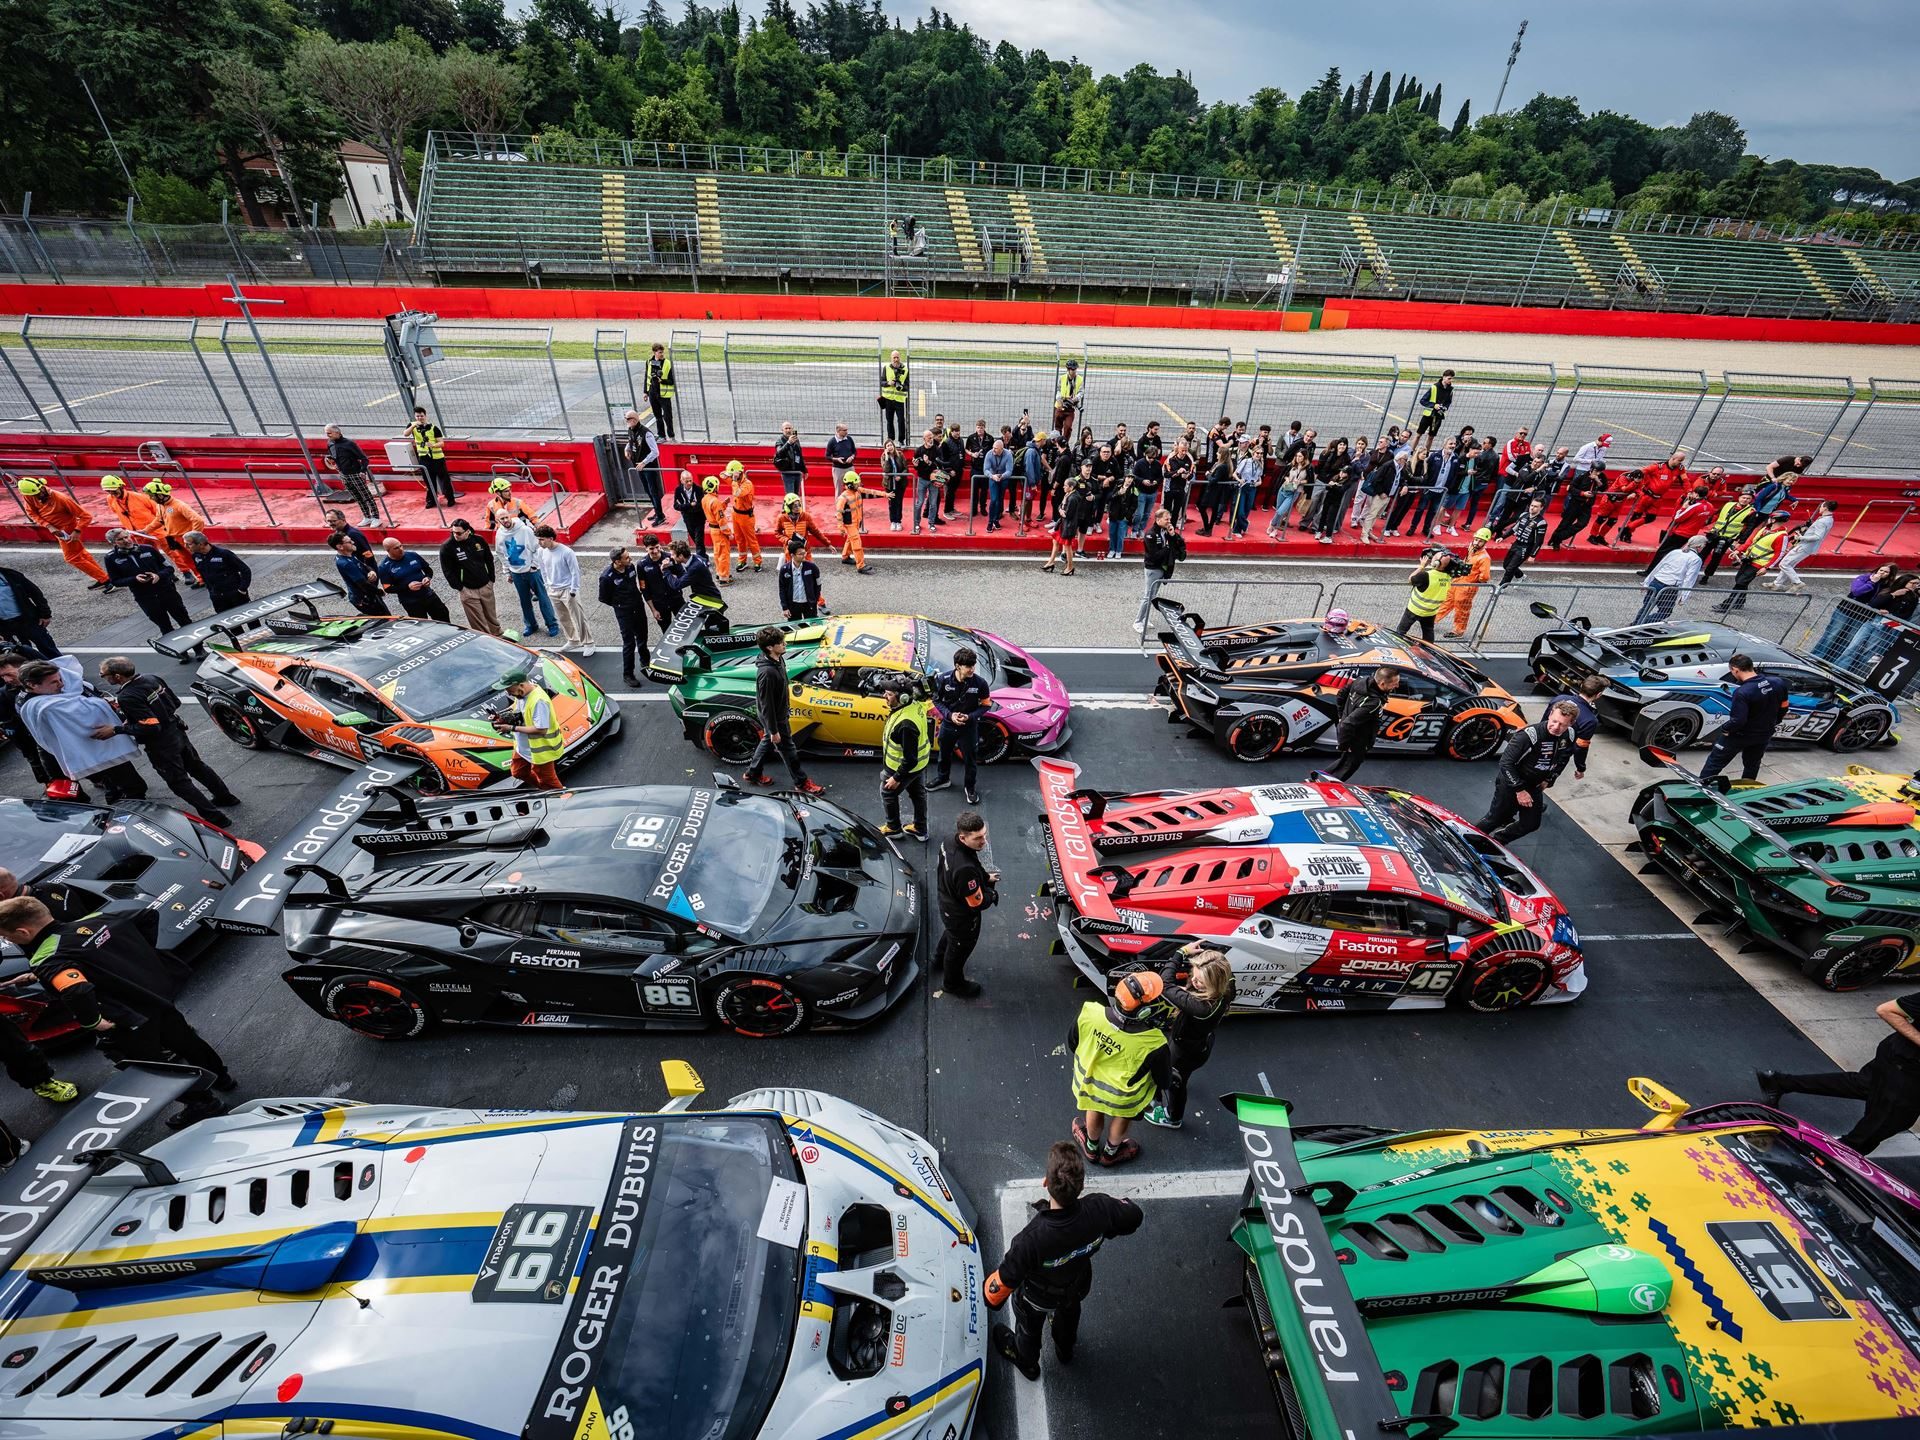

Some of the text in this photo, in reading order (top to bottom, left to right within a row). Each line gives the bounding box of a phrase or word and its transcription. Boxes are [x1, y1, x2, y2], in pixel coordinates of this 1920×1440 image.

[663, 600, 704, 647] randstad
[387, 635, 426, 652] 33
[705, 634, 757, 645] ROGER DUBU
[1203, 637, 1259, 648] ROGER DUBUIS
[375, 655, 431, 684] ROGER
[428, 630, 478, 658] DUBUIS
[1878, 656, 1910, 690] 3
[395, 685, 407, 696] 33
[288, 697, 323, 718] Fastron
[809, 696, 854, 709] Fastron
[1411, 720, 1444, 737] 25
[1801, 716, 1831, 734] 32
[444, 758, 469, 769] MPC
[283, 766, 397, 863] randstad
[1040, 769, 1090, 860] randstad
[1792, 815, 1829, 825] DUBUIS
[626, 816, 665, 848] 86
[1316, 812, 1351, 841] 46
[359, 831, 449, 844] ROGER DUBUIS
[653, 789, 711, 900] ROGER DUBUIS
[1099, 832, 1183, 846] ROGER DUBUIS
[1043, 822, 1067, 897] XEKUTORBRNO.CZ
[1308, 863, 1365, 876] ON-LINE
[1394, 836, 1435, 888] ROGER
[54, 864, 82, 885] amica
[688, 892, 706, 912] 86
[176, 897, 215, 931] Fastron
[1114, 908, 1145, 920] KARNA
[1122, 915, 1150, 931] LINE
[1339, 939, 1398, 955] Fastron
[1367, 936, 1398, 944] PERTAMINA
[510, 951, 580, 969] Fastron
[546, 948, 581, 957] PERTAMINA
[1243, 963, 1287, 971] AQUASYS
[1305, 976, 1387, 991] LERAM
[1409, 970, 1453, 990] 46
[644, 985, 692, 1007] 86
[816, 990, 859, 1007] Fastron
[1317, 999, 1346, 1007] AGRATI
[537, 1014, 570, 1023] AGRATI
[1093, 1028, 1122, 1052] MEDIA
[0, 1091, 150, 1256] dstad
[779, 1195, 791, 1224] TECHNICAL
[782, 1190, 798, 1231] SCRUTINEERING
[1731, 1146, 1861, 1270] DUBUIS
[490, 1221, 513, 1264] macron
[494, 1211, 569, 1292] 66
[1242, 1125, 1361, 1382] randstad
[1722, 1241, 1760, 1284] macron
[38, 1260, 198, 1282] ROGER DUBUIS
[544, 1125, 658, 1423] ROGER DUBUIS
[803, 1245, 820, 1313] Dinamica
[1733, 1238, 1815, 1304] 61
[968, 1264, 980, 1335] Fastron
[1366, 1287, 1508, 1310] ROGER DUBUIS
